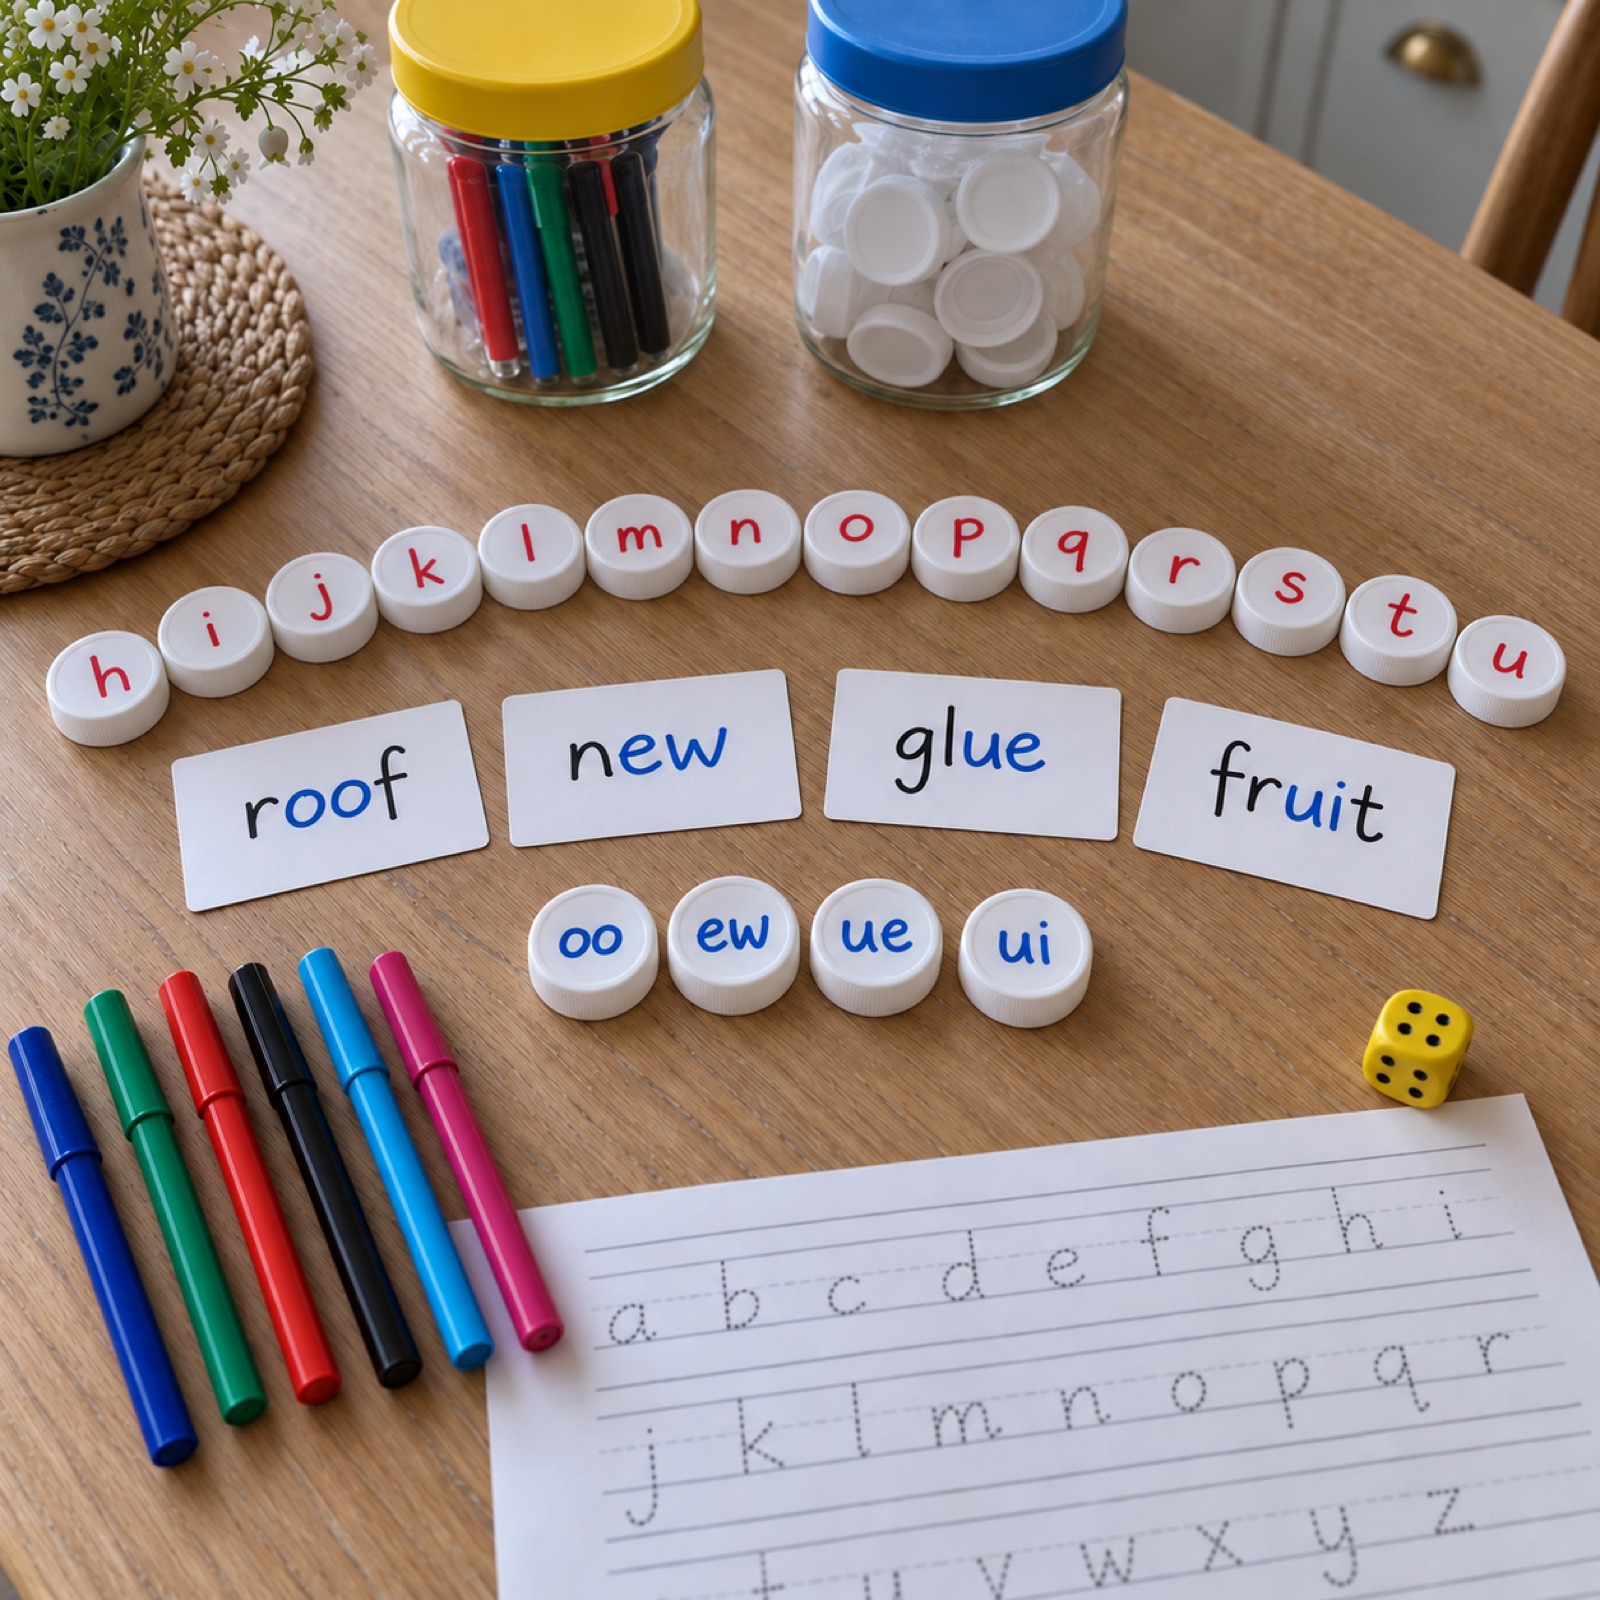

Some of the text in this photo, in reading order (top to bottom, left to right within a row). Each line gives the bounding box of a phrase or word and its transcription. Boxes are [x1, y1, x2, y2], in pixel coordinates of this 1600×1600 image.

[616, 524, 663, 553] m
[730, 518, 762, 546] n
[839, 513, 875, 543] o
[953, 517, 985, 559] p
[408, 547, 445, 589] k
[1057, 530, 1089, 573] q
[1169, 555, 1201, 584] r
[310, 573, 333, 621] j
[1274, 571, 1307, 605] s
[203, 611, 220, 647] i
[1388, 593, 1418, 638] t
[90, 655, 131, 698] h
[1492, 642, 1528, 679] u
[569, 725, 729, 782] new
[894, 704, 1047, 796] glue
[244, 744, 408, 840] roof
[1210, 740, 1385, 844] fruit
[557, 923, 624, 960] oo
[696, 913, 771, 954] ew
[841, 918, 914, 954] ue
[998, 919, 1052, 967] ui
[609, 1186, 1463, 1345] a b c d e f g h i
[626, 1332, 1510, 1527] j k l m n o p q r
[752, 1551, 786, 1600] t
[976, 1552, 1012, 1600] v
[1080, 1536, 1134, 1587] w
[1197, 1521, 1243, 1571] x
[1310, 1505, 1357, 1587] y
[1427, 1487, 1475, 1535] z
